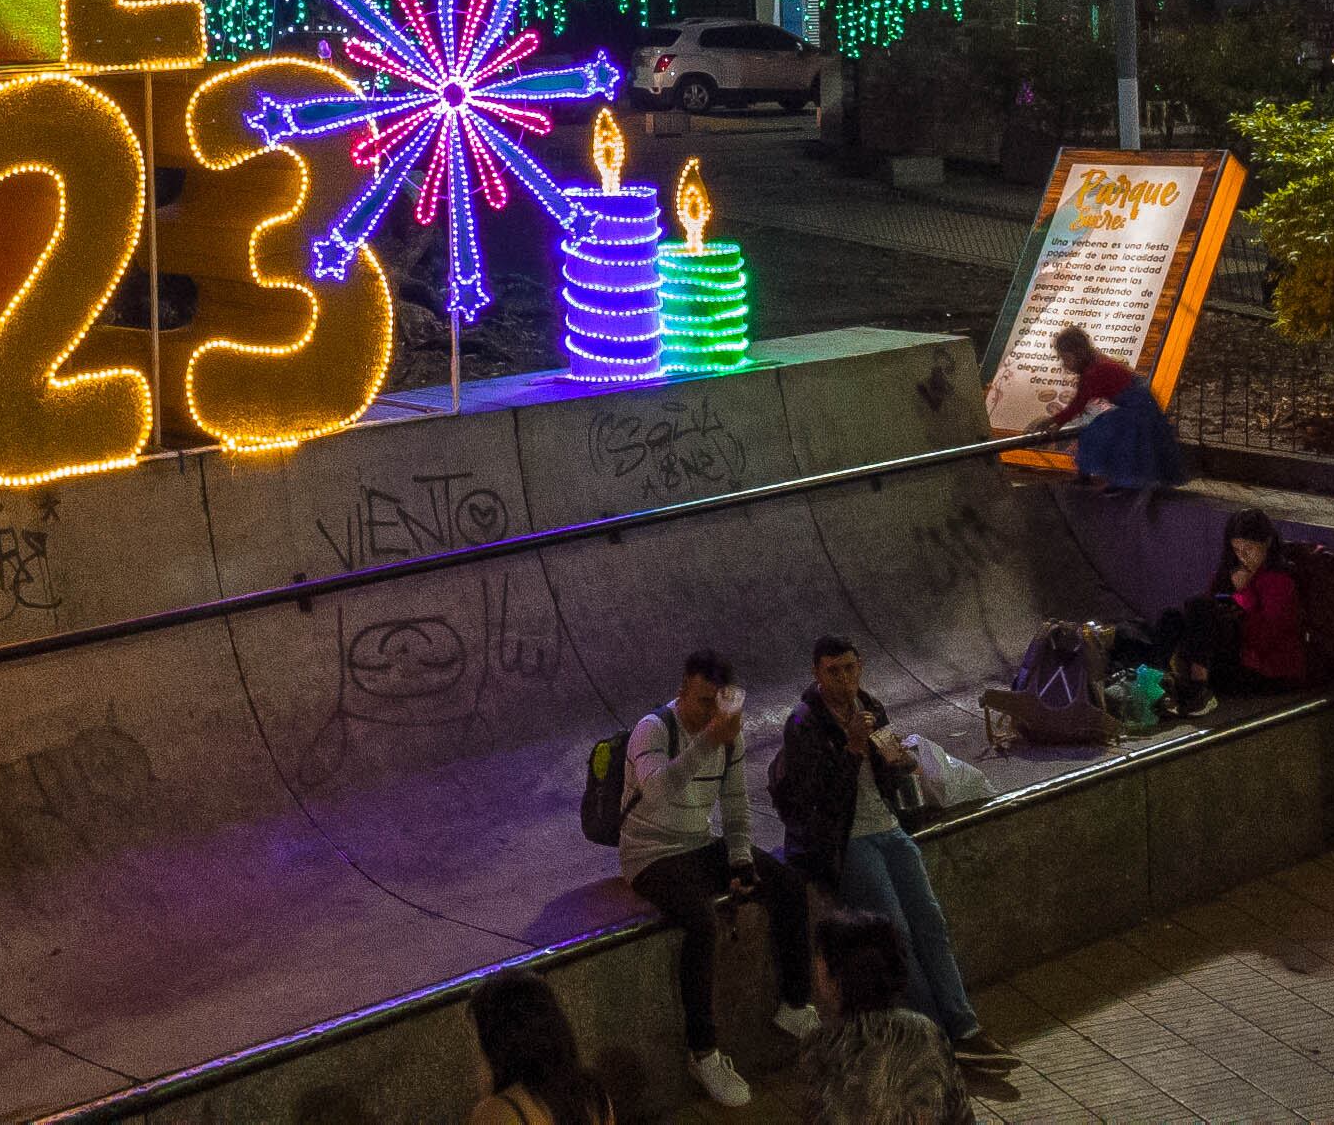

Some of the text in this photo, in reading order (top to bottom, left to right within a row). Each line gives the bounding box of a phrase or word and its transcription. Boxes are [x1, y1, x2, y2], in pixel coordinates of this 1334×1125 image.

[1075, 169, 1181, 221] Parque
[1051, 238, 1068, 246] Una
[1071, 238, 1108, 249] verbena
[1124, 242, 1142, 250] una
[1144, 241, 1170, 252] fiesta
[1046, 250, 1081, 259] popular
[1085, 250, 1097, 260] de
[1101, 252, 1118, 261] una
[1051, 262, 1063, 270] un
[1065, 261, 1092, 271] barrio
[1094, 263, 1106, 272] de
[1109, 265, 1126, 273] una
[1129, 264, 1163, 275] ciudad
[1053, 272, 1082, 282] donde
[1034, 283, 1154, 299] personas disfrutando de
[1068, 297, 1120, 308] actividades
[1122, 301, 1150, 309] como
[1063, 307, 1102, 318] comidas
[1022, 315, 1074, 328] actividades
[1090, 322, 1102, 330] un
[1105, 322, 1142, 334] espacio
[1014, 339, 1031, 348] con
[1033, 339, 1046, 348] los
[1093, 334, 1138, 346] compartir
[1010, 350, 1060, 363] agradables
[1050, 366, 1062, 374] en
